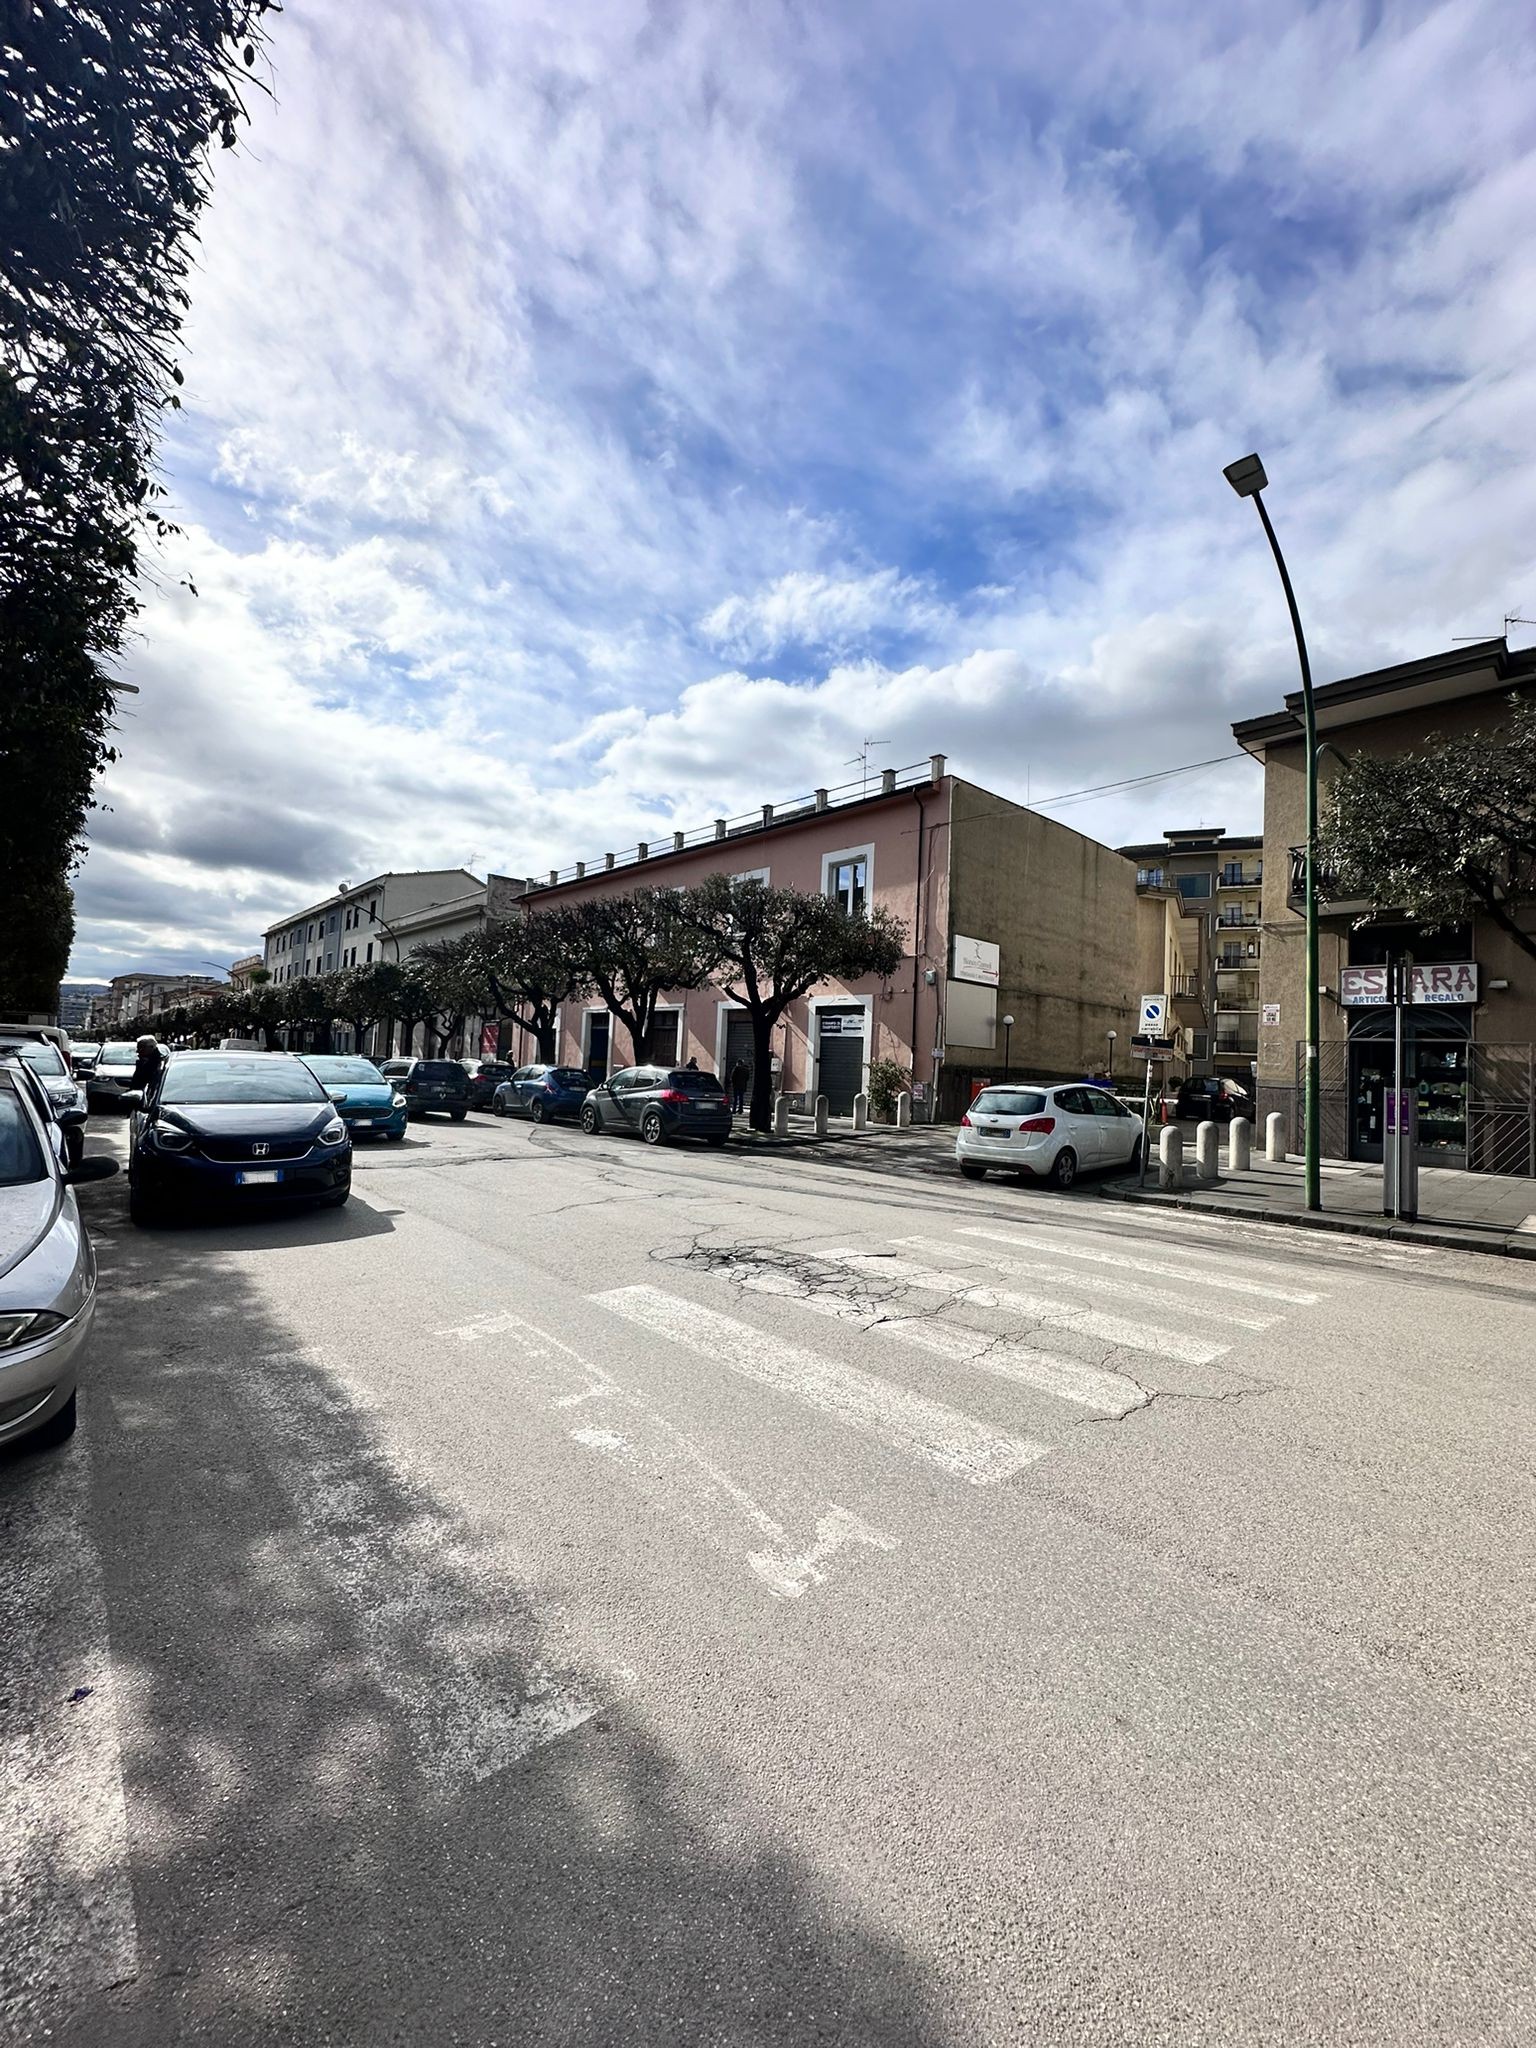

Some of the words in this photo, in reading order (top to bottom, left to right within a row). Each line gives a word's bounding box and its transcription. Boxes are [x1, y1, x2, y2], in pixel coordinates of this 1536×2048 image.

[1343, 966, 1475, 995] ESARA
[1352, 995, 1388, 1004] ARTICO
[1424, 993, 1464, 1002] REGALO
